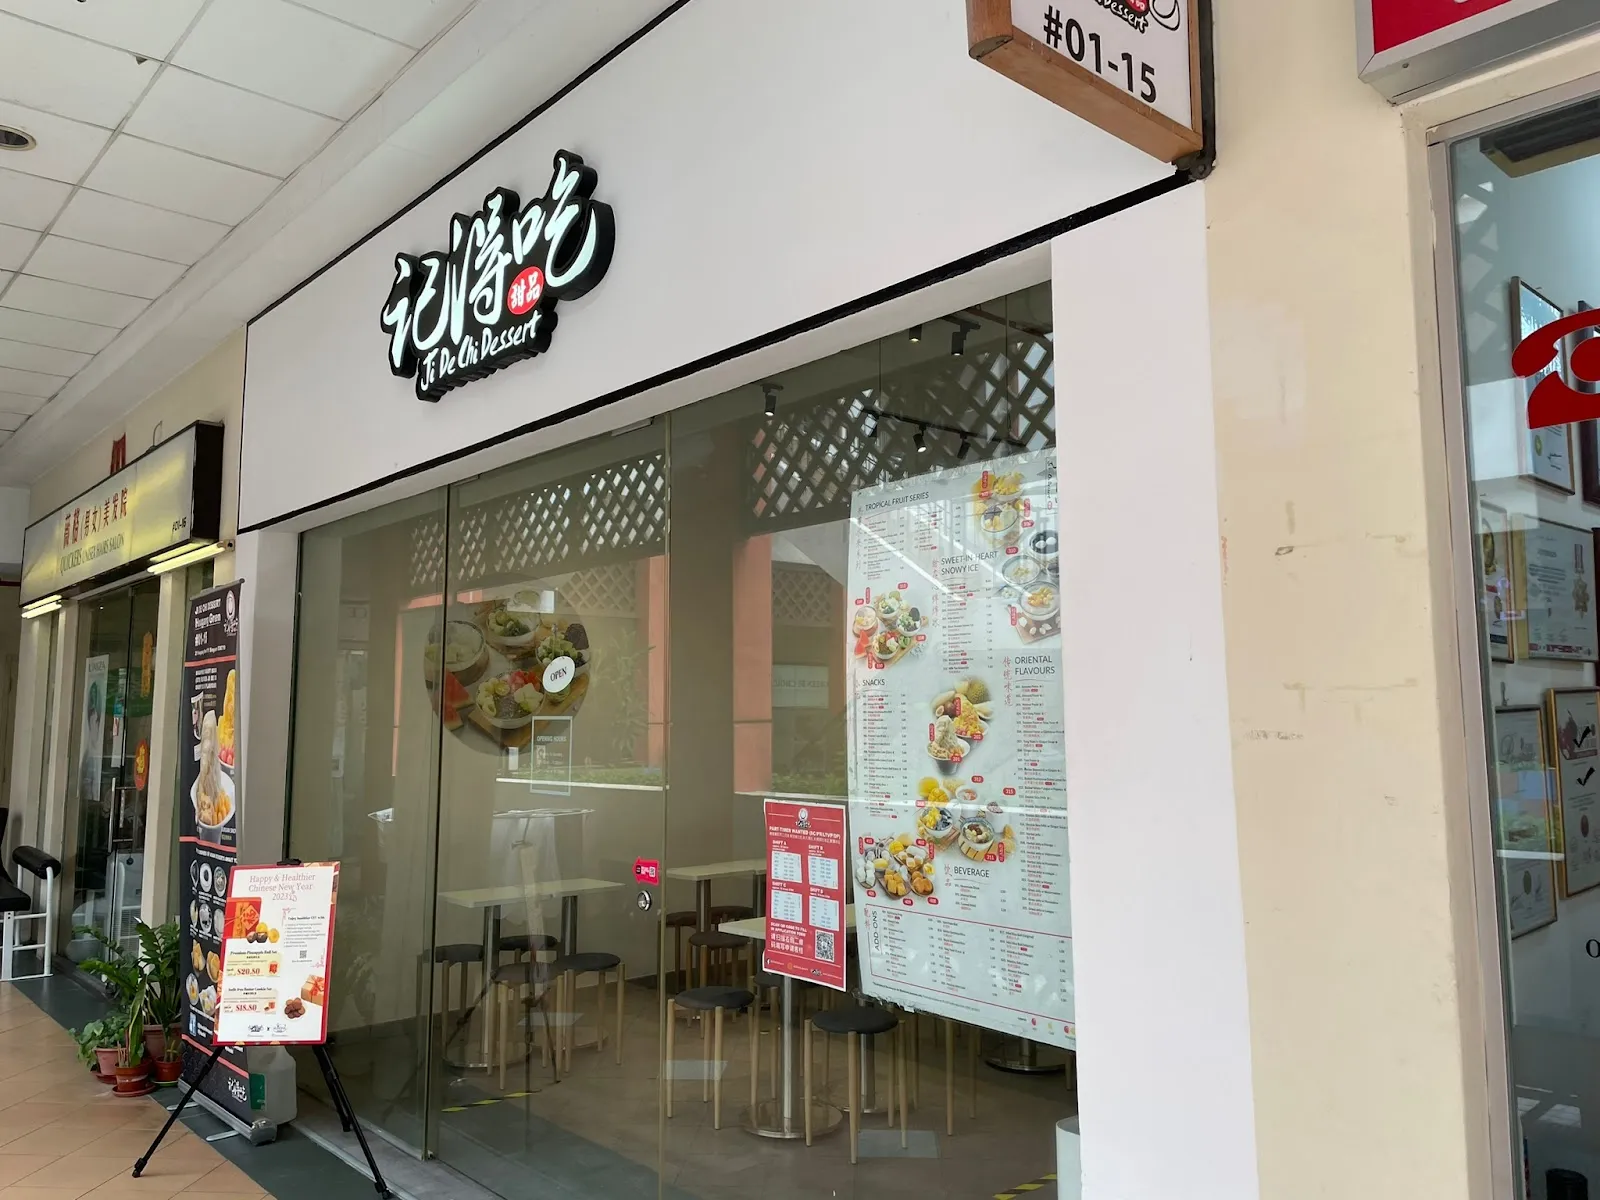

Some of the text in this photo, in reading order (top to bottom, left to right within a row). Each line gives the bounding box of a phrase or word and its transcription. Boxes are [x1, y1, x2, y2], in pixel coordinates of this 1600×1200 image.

[1043, 5, 1157, 103] #01-15
[511, 271, 541, 309] 甜品
[439, 347, 455, 378] De
[457, 335, 479, 369] Chi
[480, 310, 543, 360] Dessert
[865, 492, 930, 511] TROPICAL FRUIT SERIES
[941, 564, 979, 576] SNOWY ICE
[1014, 655, 1053, 665] ORIENTAL
[550, 666, 567, 682] OPEN
[1015, 666, 1056, 676] FLAVOURS
[862, 678, 886, 687] SNACKS
[953, 866, 990, 878] BEVERAGE
[249, 875, 273, 885] Happy
[281, 872, 316, 882] Healthier
[248, 882, 313, 892] Chinese New Year
[272, 893, 289, 901] 2023
